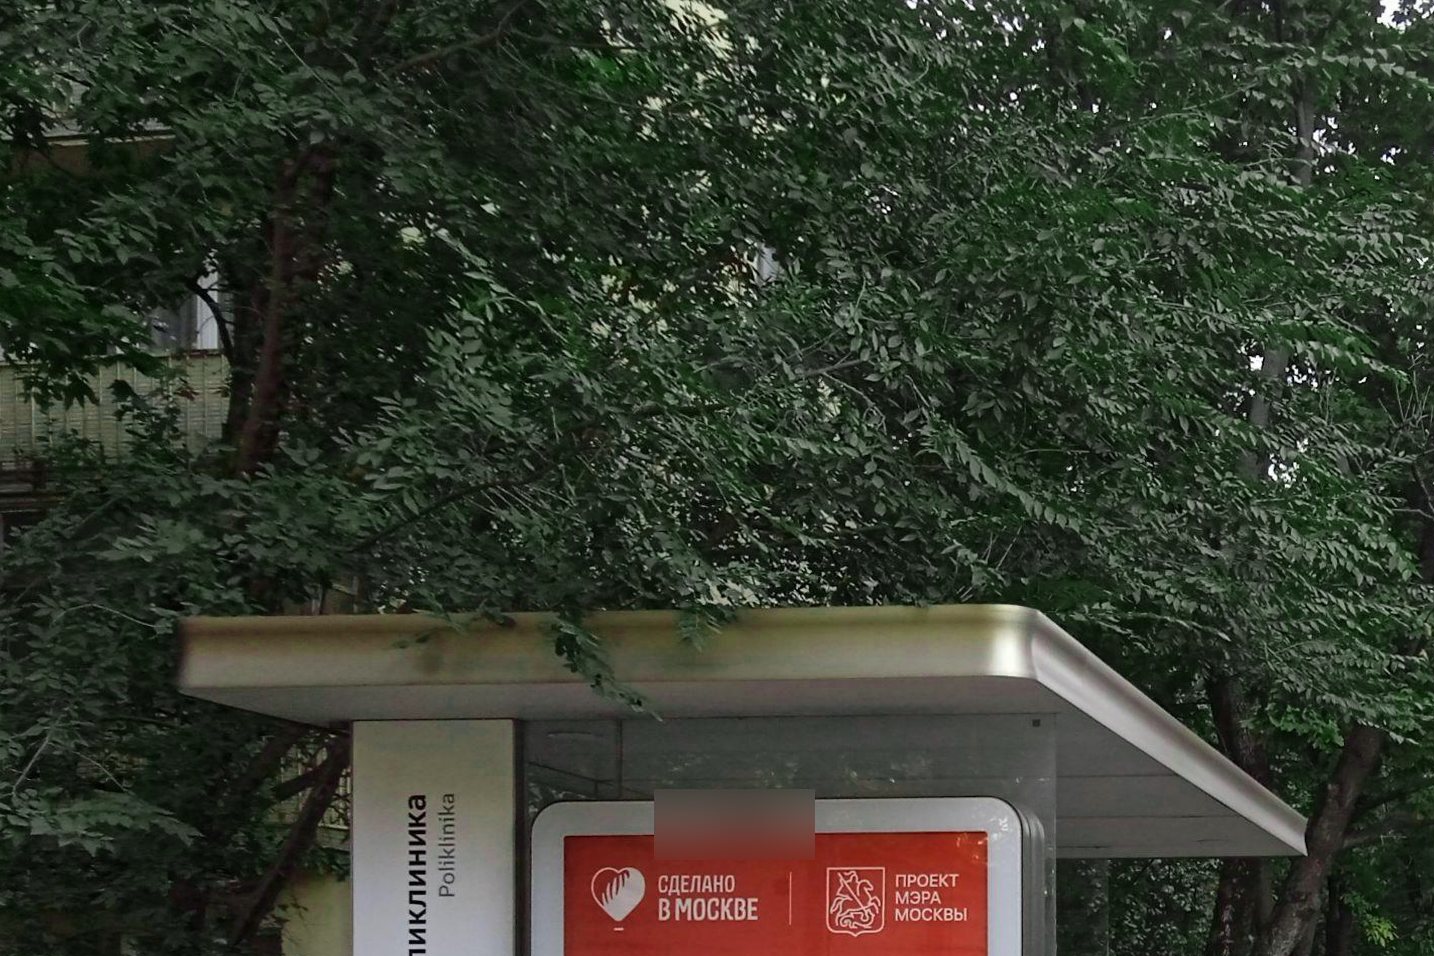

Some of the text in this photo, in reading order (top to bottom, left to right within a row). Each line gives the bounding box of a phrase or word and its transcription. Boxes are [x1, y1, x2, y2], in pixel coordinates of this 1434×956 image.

[438, 793, 455, 897] Poliklinika
[658, 875, 735, 895] СДЕЛАНО
[895, 874, 959, 887] ПРОЕКТ
[895, 891, 941, 904] МЭРА
[658, 898, 759, 921] В МОСКВЕ
[895, 908, 967, 921] МОСКВЫ
